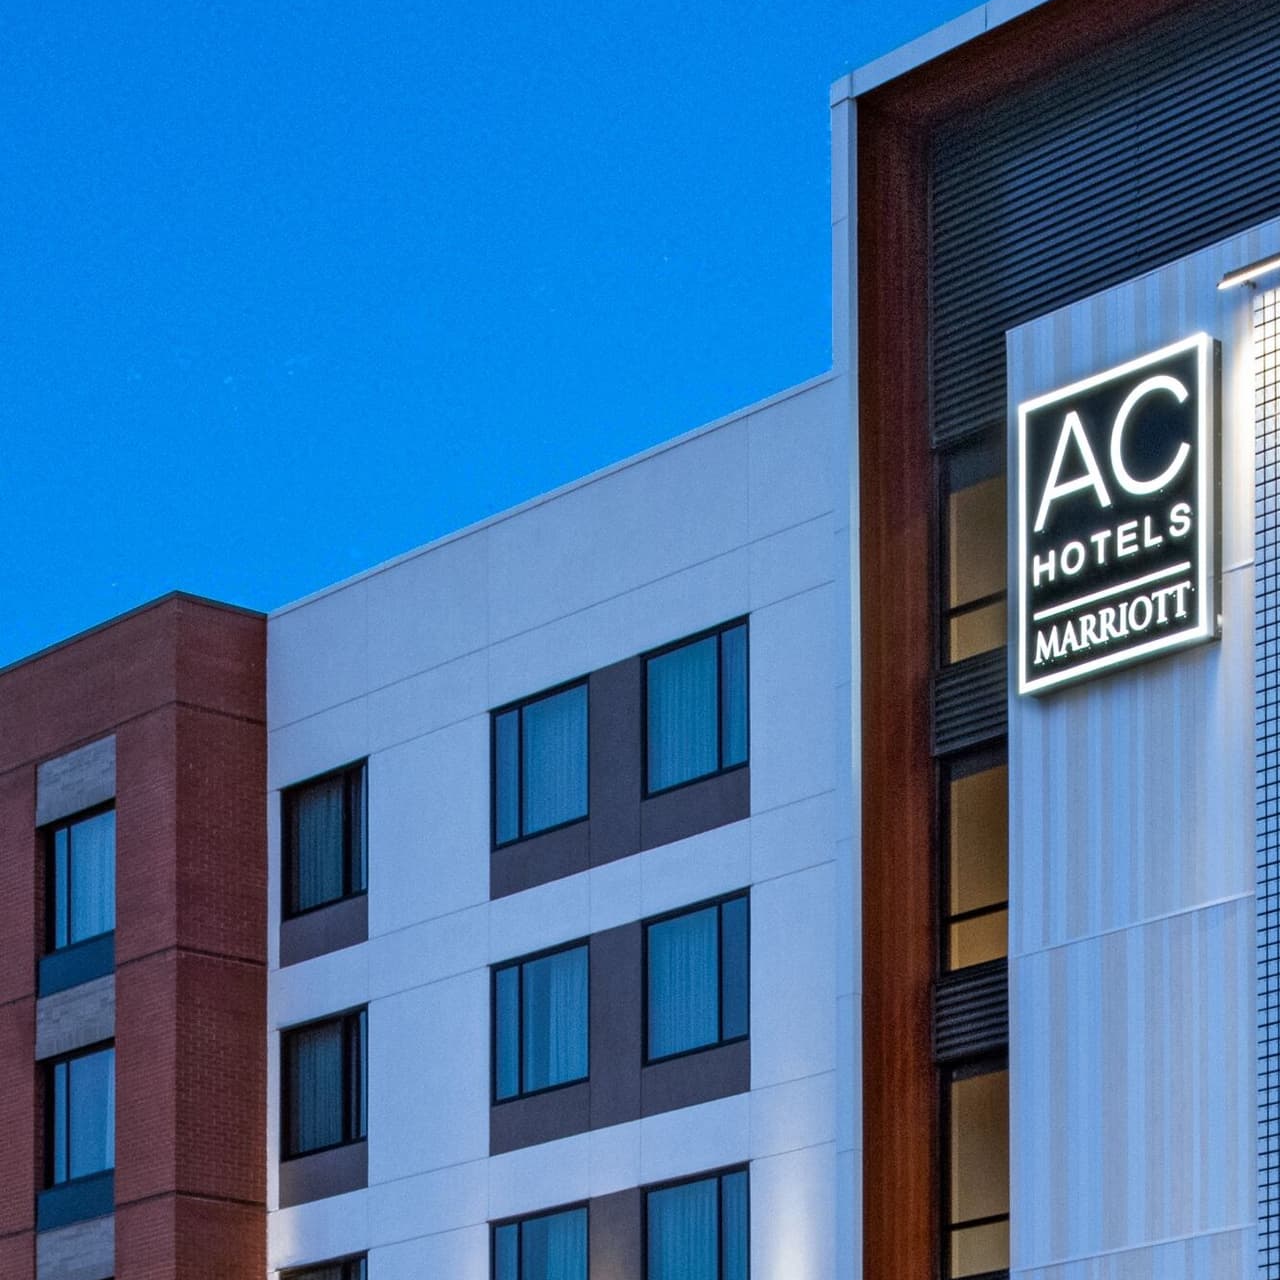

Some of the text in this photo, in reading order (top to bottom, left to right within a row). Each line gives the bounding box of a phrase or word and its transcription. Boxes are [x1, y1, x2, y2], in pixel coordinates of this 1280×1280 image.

[1033, 375, 1191, 533] AC
[1032, 502, 1192, 587] HOTELS
[1033, 580, 1192, 665] MARRIOTT
